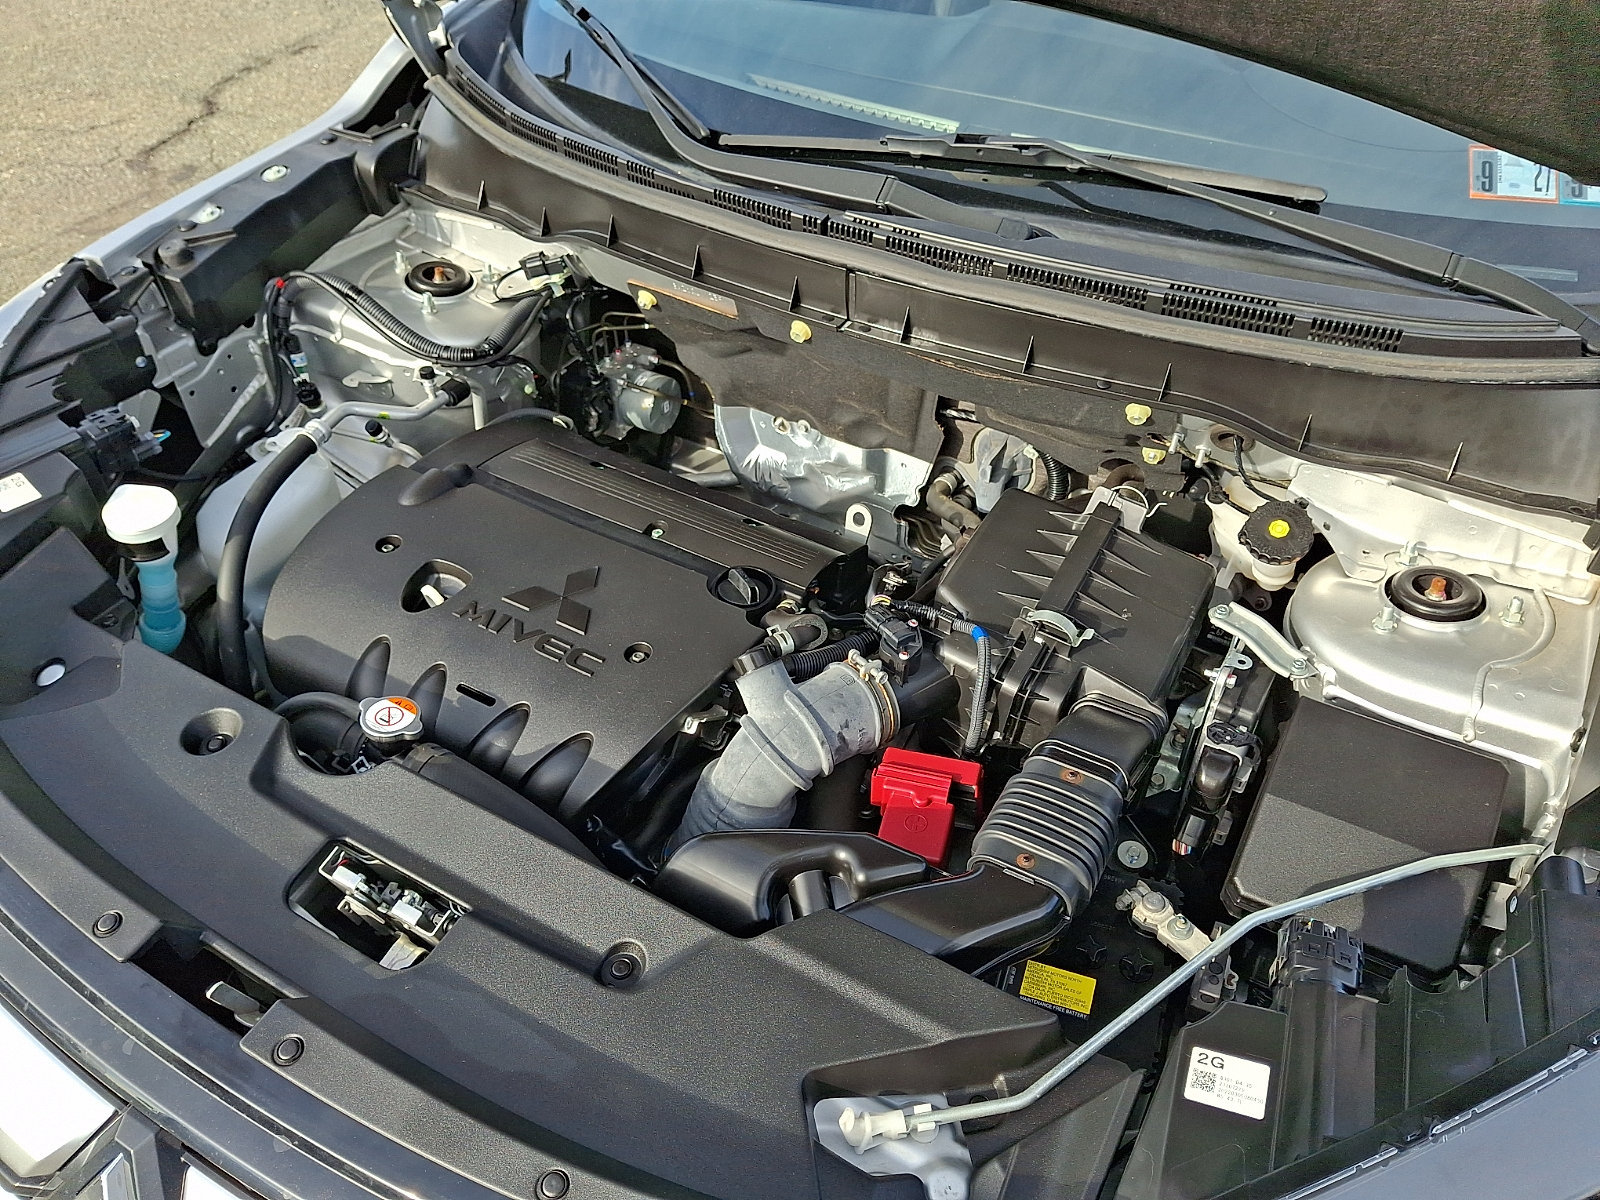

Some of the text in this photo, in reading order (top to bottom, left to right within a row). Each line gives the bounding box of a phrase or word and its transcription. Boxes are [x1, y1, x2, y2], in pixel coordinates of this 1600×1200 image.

[1481, 160, 1494, 192] 9
[452, 600, 606, 678] MIVEC
[1020, 996, 1052, 1010] MAINTENANCE
[1066, 1009, 1087, 1019] BATTERY
[1197, 1052, 1224, 1070] 2G
